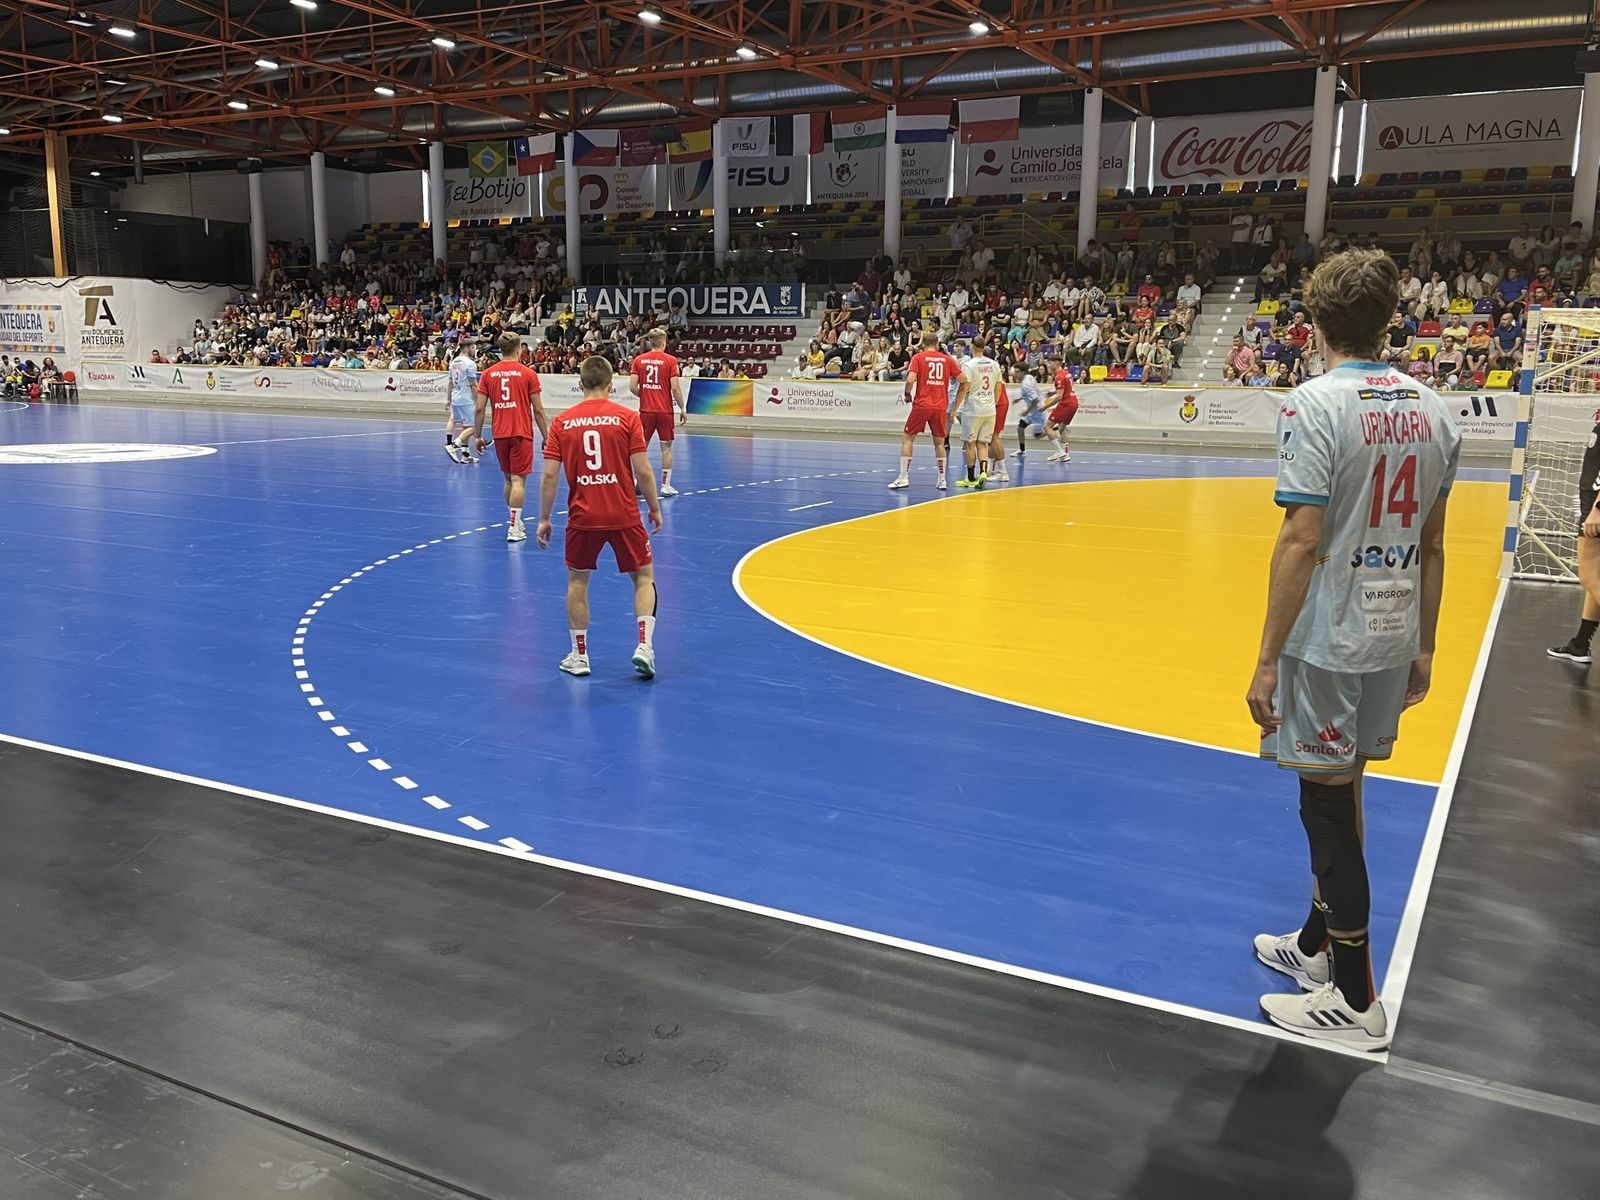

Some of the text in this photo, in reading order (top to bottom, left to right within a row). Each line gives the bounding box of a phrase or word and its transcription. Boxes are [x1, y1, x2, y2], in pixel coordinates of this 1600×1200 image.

[1380, 117, 1561, 148] AULA MAGNA
[732, 142, 757, 151] FISU
[901, 148, 915, 157] SU
[1011, 143, 1083, 160] Universida
[1160, 119, 1313, 179] Coca-Cola
[901, 168, 929, 177] VERSITY
[1010, 159, 1057, 175] Camilo
[1058, 158, 1082, 173] Jos
[1010, 173, 1080, 184] SEK EDUCATION GRO
[453, 177, 526, 205] El Botijo
[615, 185, 640, 195] Consejo
[816, 191, 869, 200] ANTEQUERA 2024
[595, 286, 771, 315] ANTEQUERA
[81, 336, 125, 345] ANTEQUERA
[645, 364, 659, 384] 21
[928, 362, 944, 380] 20
[311, 377, 362, 392] ANTEQUERA
[400, 377, 434, 385] Universidad
[400, 384, 420, 392] Camilo
[982, 375, 990, 391] 3
[500, 377, 510, 401] 5
[787, 387, 834, 398] Universidad
[787, 396, 852, 407] Camilo José Cela
[562, 415, 620, 430] ZAWADZKI
[1455, 420, 1480, 428] utación
[1471, 427, 1495, 435] Málaga
[583, 430, 603, 471] 9
[1368, 453, 1419, 529] 14
